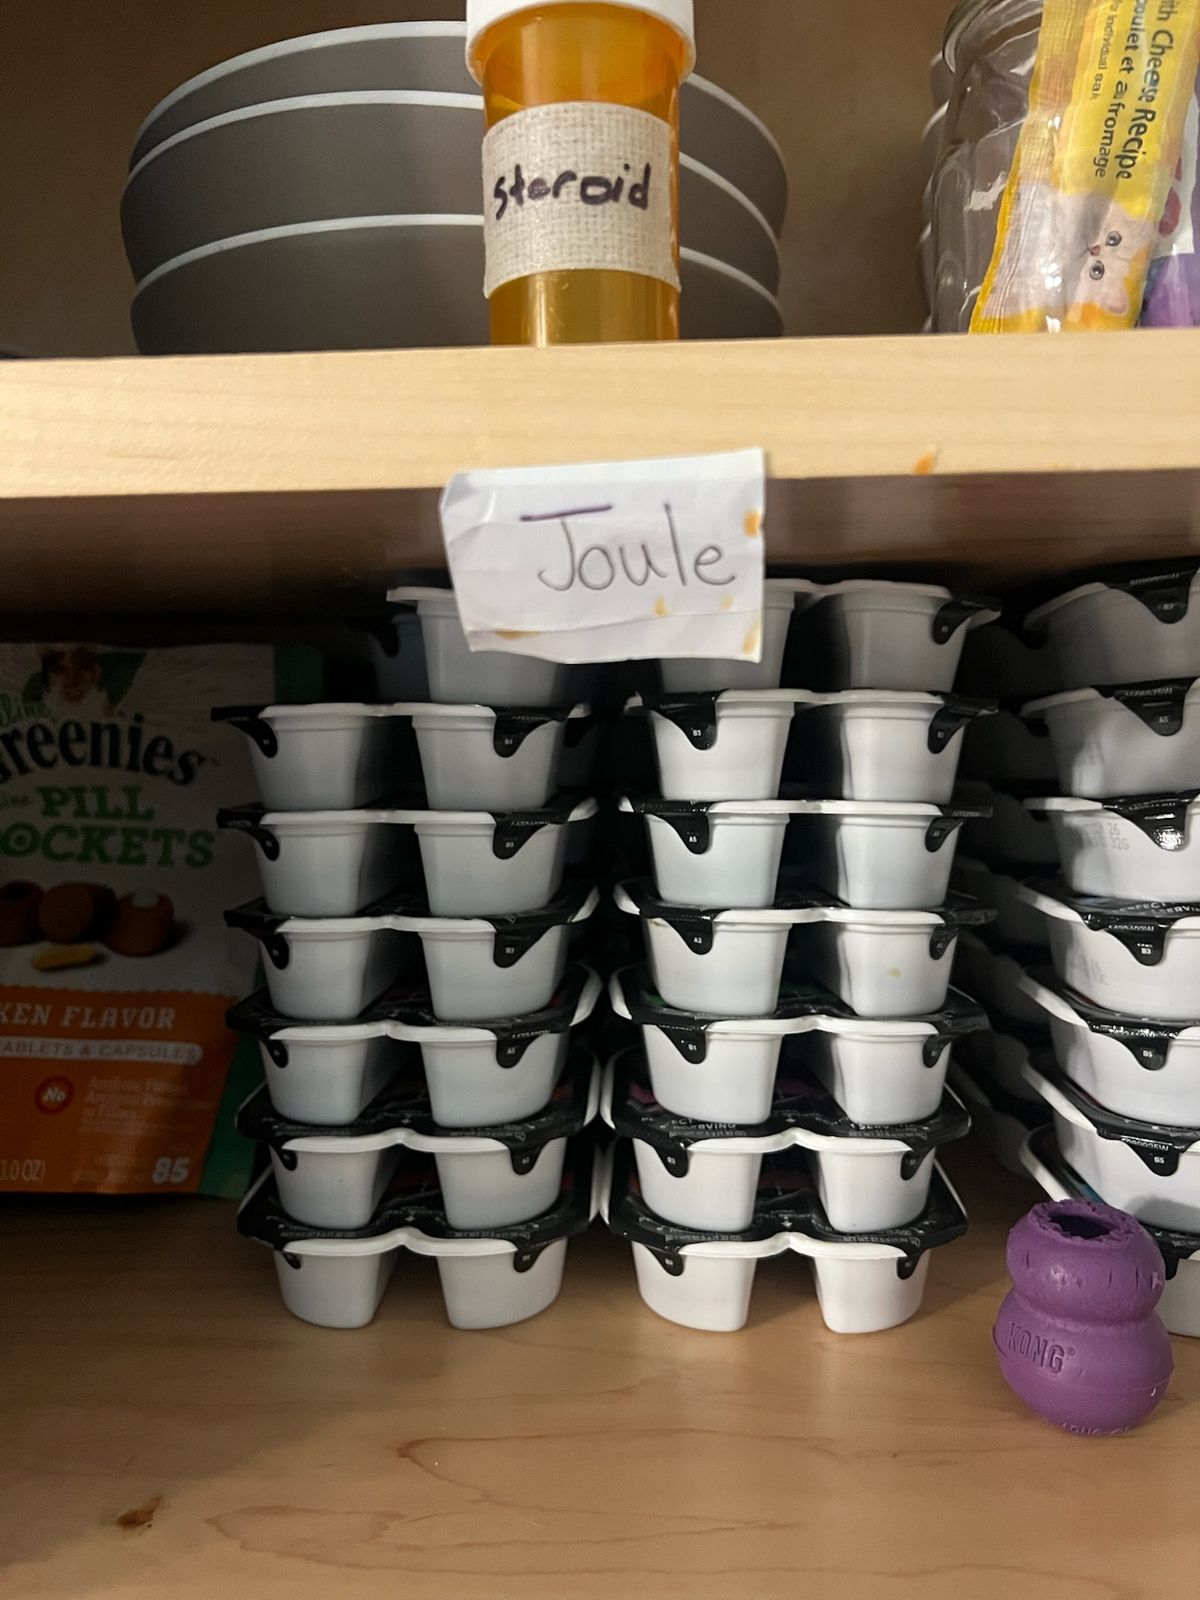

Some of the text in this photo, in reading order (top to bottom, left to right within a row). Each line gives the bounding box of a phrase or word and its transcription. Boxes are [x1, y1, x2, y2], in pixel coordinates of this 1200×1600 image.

[1119, 56, 1135, 74] et
[1137, 29, 1174, 103] Cheese
[1093, 102, 1126, 178] fromage
[1114, 108, 1157, 180] Recipe
[492, 161, 652, 220] steroid
[519, 502, 736, 591] Joule
[0, 714, 207, 784] reenies
[36, 785, 155, 821] PILL
[61, 1004, 177, 1030] FLAVOR
[41, 1085, 66, 1103] No
[152, 1155, 191, 1185] 85
[1007, 1321, 1067, 1375] KONG
